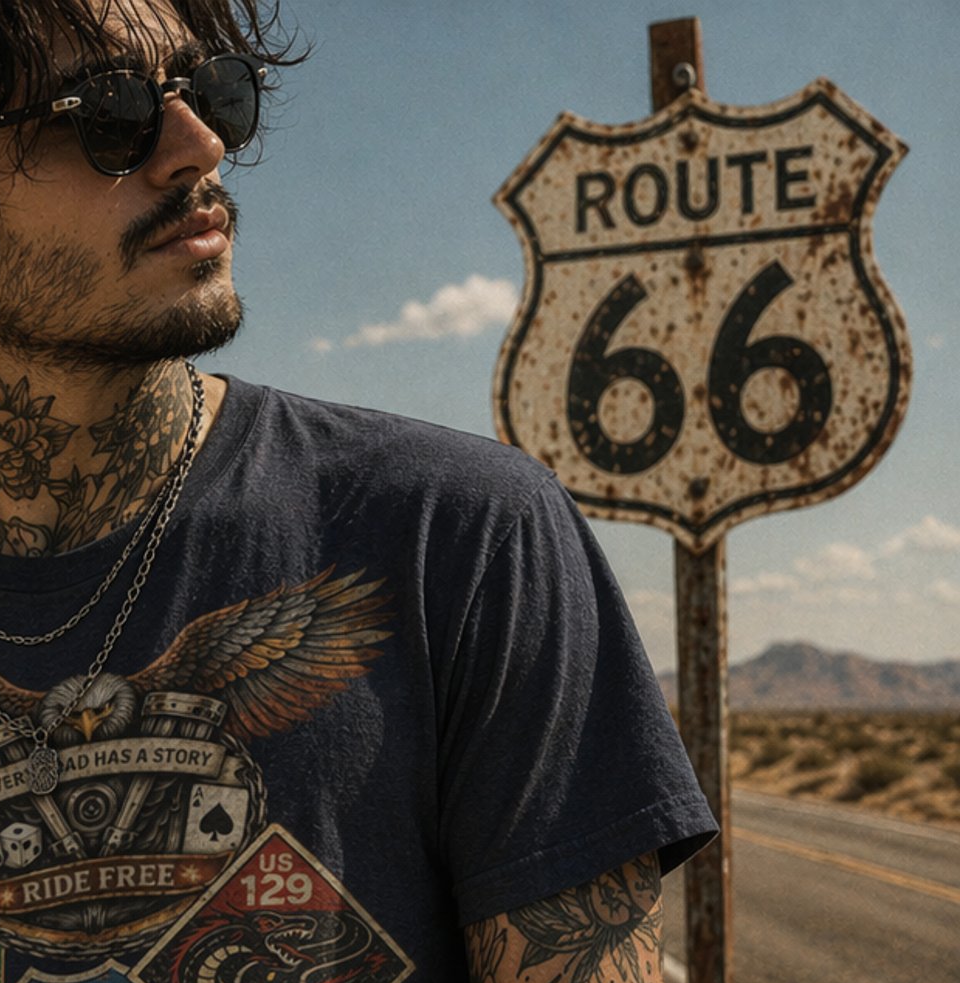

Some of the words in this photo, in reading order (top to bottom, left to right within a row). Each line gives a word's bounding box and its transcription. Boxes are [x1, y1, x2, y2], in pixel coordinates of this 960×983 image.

[574, 145, 818, 235] ROUTE
[566, 260, 834, 476] 66
[94, 749, 130, 768] HAS
[136, 749, 148, 764] A
[153, 748, 213, 767] STORY
[258, 853, 293, 873] US
[22, 871, 90, 904] RIDE
[99, 863, 175, 890] FREE
[240, 873, 313, 907] 129
